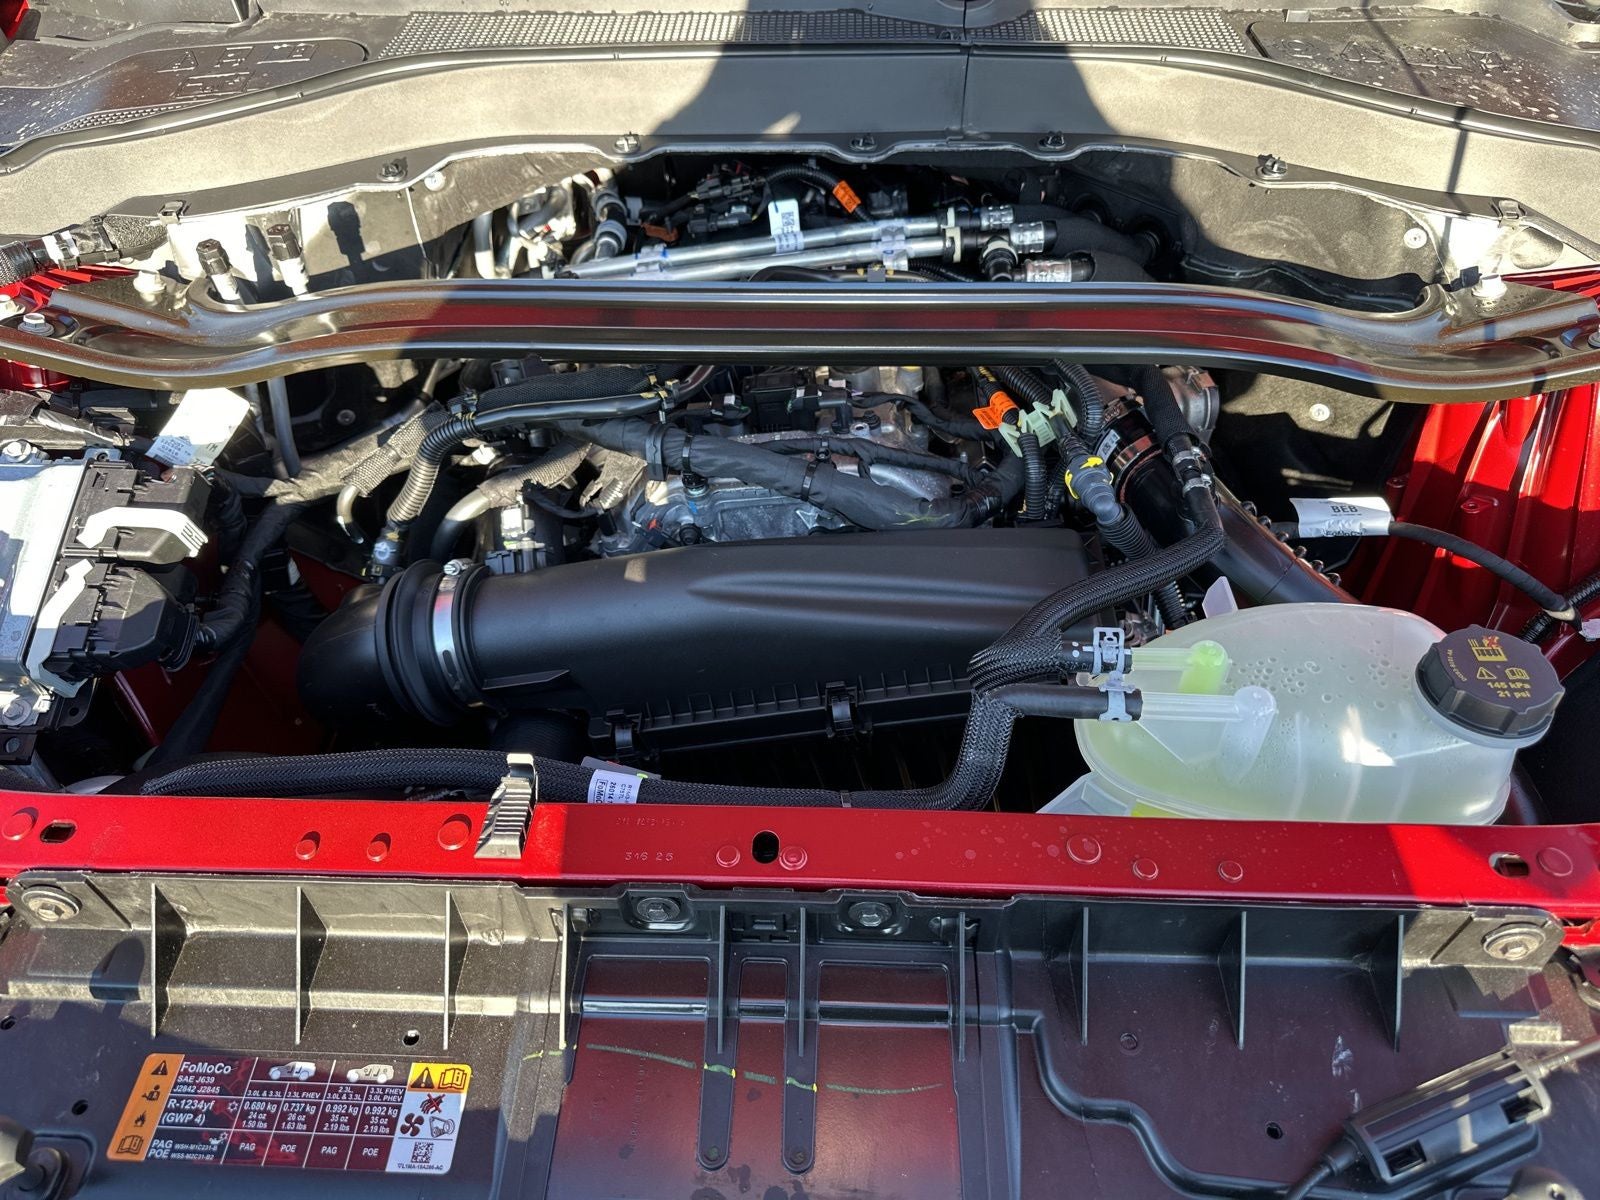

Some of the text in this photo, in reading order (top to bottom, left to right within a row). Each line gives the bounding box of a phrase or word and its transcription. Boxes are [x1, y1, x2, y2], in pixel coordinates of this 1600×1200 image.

[1331, 505, 1358, 513] BEB
[1487, 681, 1507, 689] 145
[1513, 690, 1531, 699] psi
[180, 1062, 232, 1074] FoMoCo
[197, 1086, 220, 1094] J2845
[167, 1099, 215, 1111] R-1234yf
[244, 1101, 277, 1112] 0.680 kg
[283, 1102, 316, 1114] 0.737 kg
[325, 1104, 358, 1115] 0.992 kg
[248, 1111, 257, 1119] 24
[364, 1105, 398, 1117] 0.992 kg
[161, 1112, 206, 1126] (GWP 4)
[370, 1116, 379, 1124] 35
[242, 1120, 256, 1128] 1.50
[296, 1122, 307, 1130] lbs
[323, 1123, 350, 1132] 2.19 lbs
[363, 1125, 390, 1134] 2.19 lbs
[151, 1139, 173, 1148] PAG
[239, 1142, 256, 1151] PAG
[280, 1144, 297, 1152] POE
[147, 1149, 170, 1158] POE
[321, 1146, 338, 1154] PAG
[362, 1148, 379, 1156] POE
